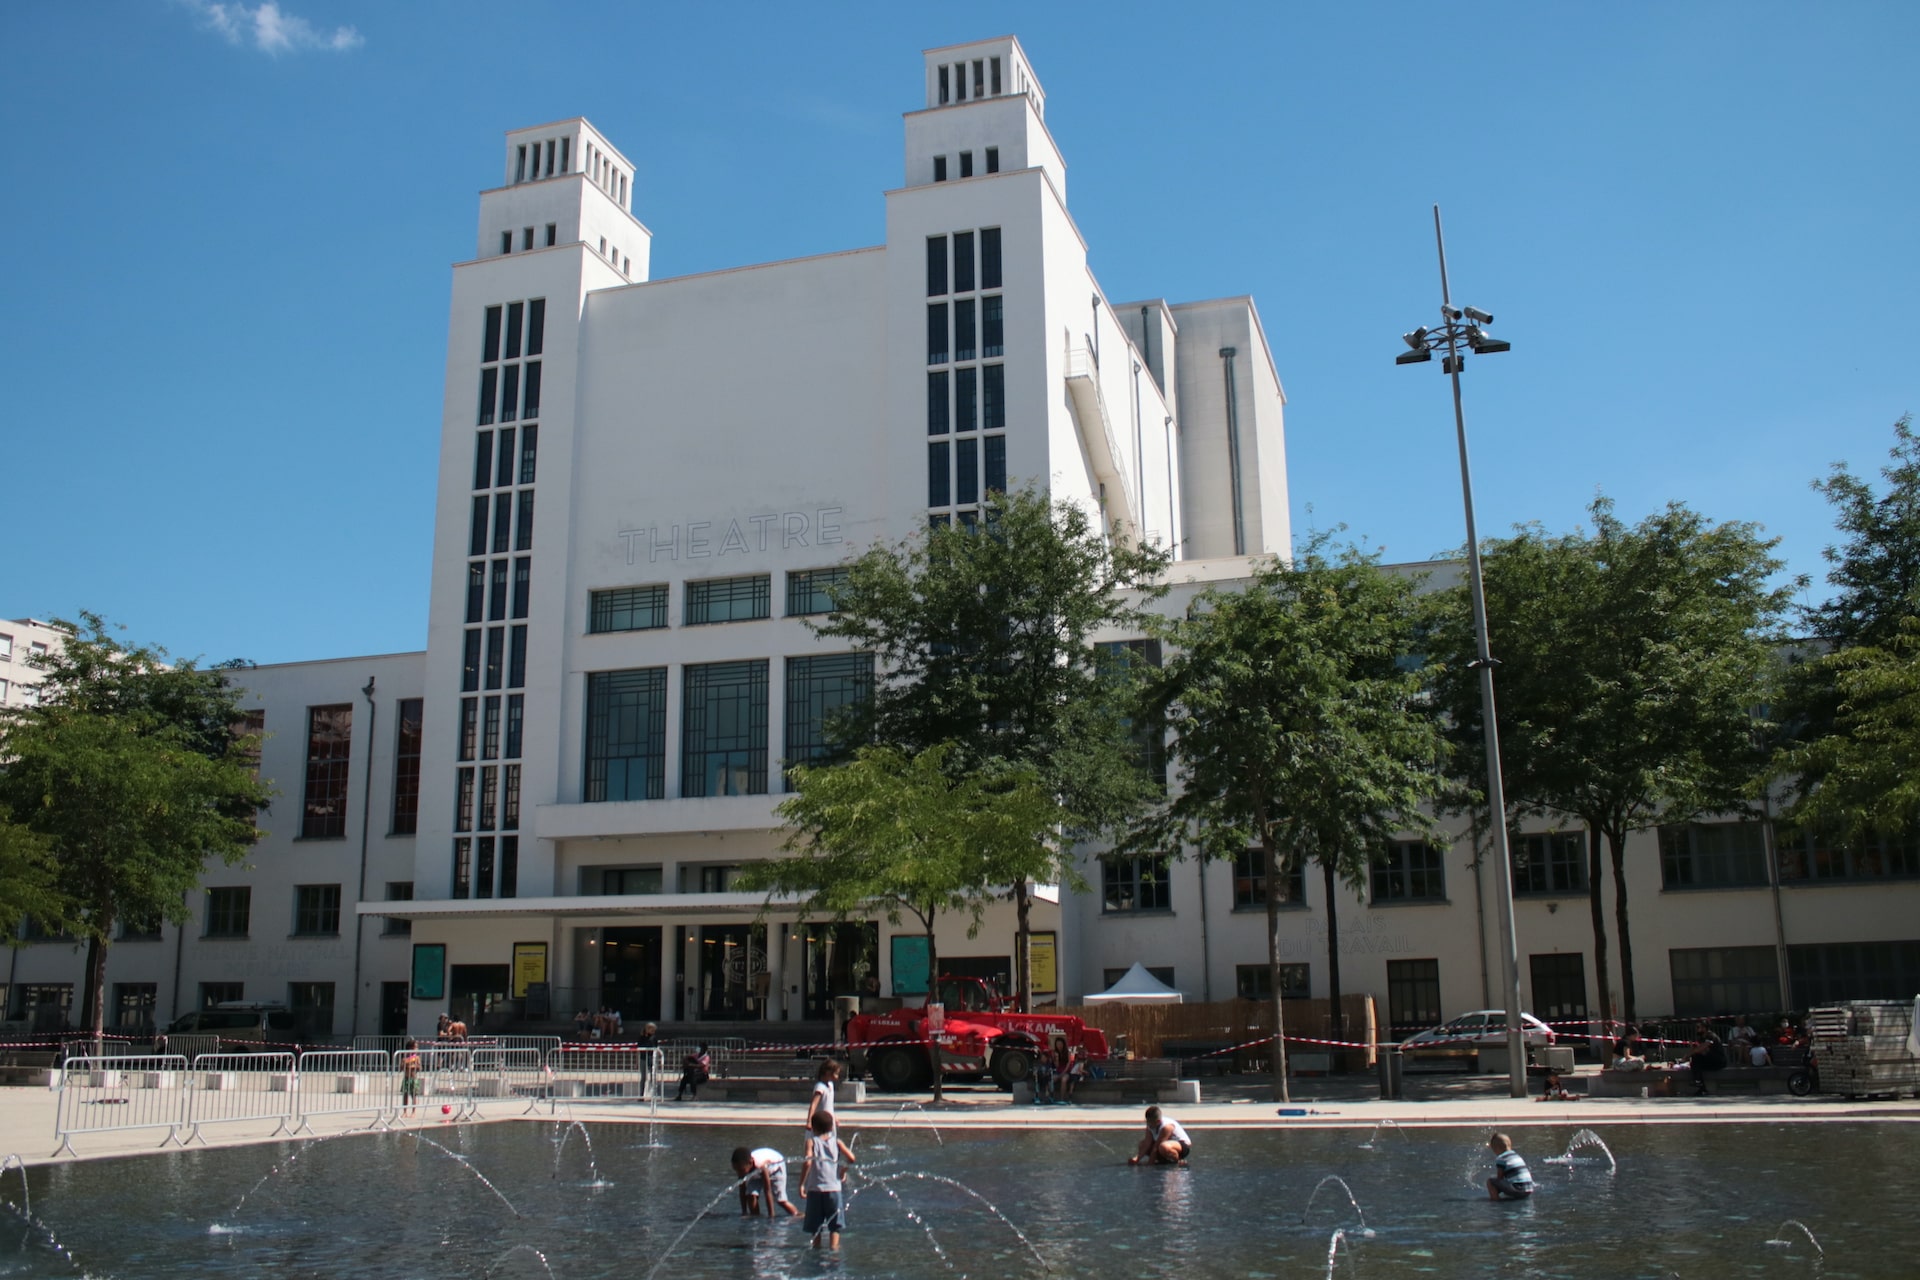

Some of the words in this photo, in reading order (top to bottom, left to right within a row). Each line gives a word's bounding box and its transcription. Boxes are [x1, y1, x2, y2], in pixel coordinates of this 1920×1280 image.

[618, 507, 843, 565] THEATRE
[1305, 915, 1387, 936] PALAIS
[1280, 937, 1312, 956] DU
[1319, 935, 1417, 955] TRAVAIL
